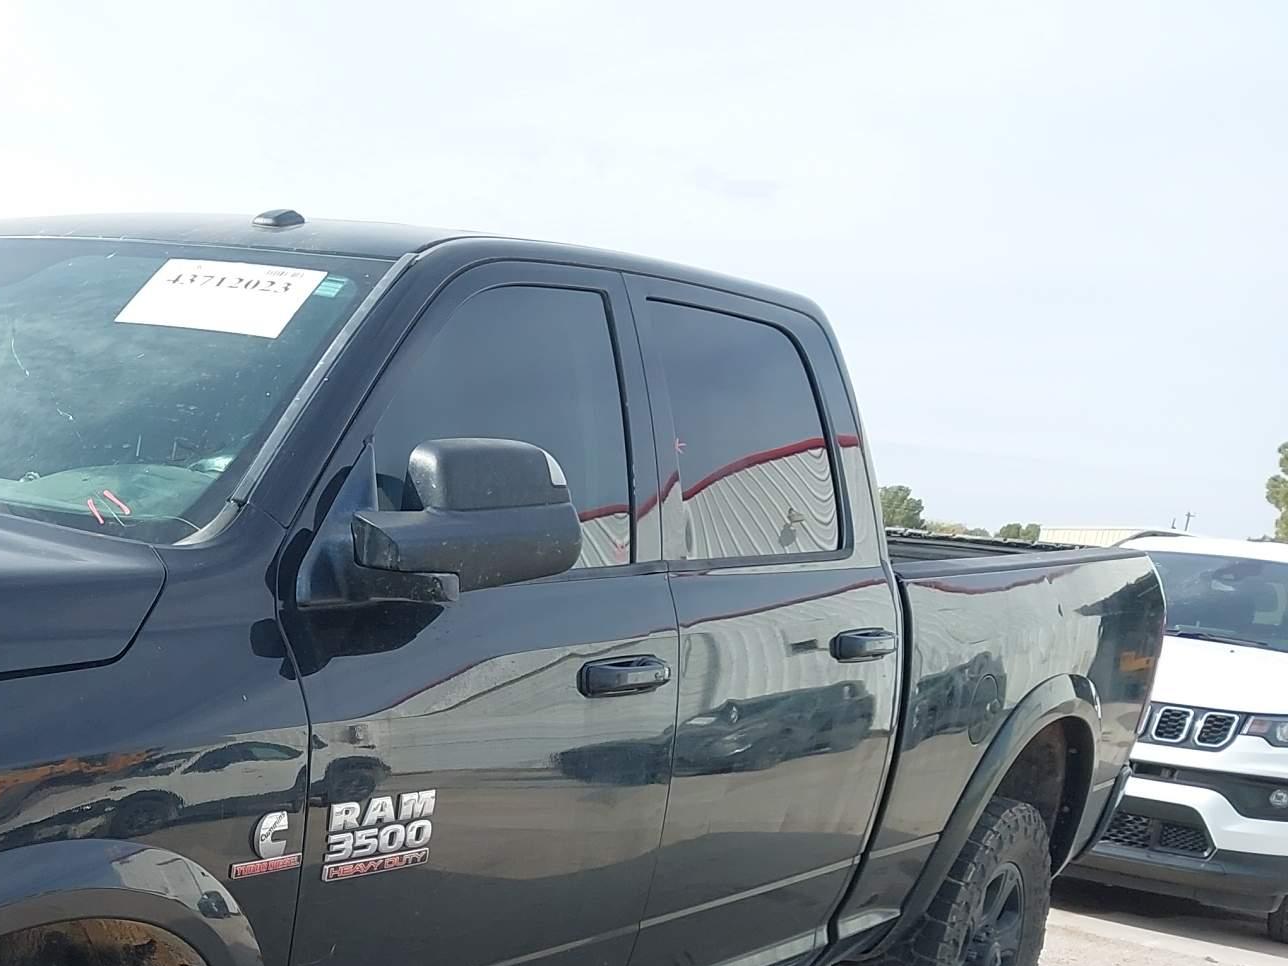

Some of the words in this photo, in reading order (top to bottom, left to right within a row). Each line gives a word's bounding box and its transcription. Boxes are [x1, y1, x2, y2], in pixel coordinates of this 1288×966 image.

[330, 790, 436, 832] RAM
[325, 819, 433, 863] 3500
[328, 859, 383, 879] HEAVY
[384, 851, 426, 869] DUTY
